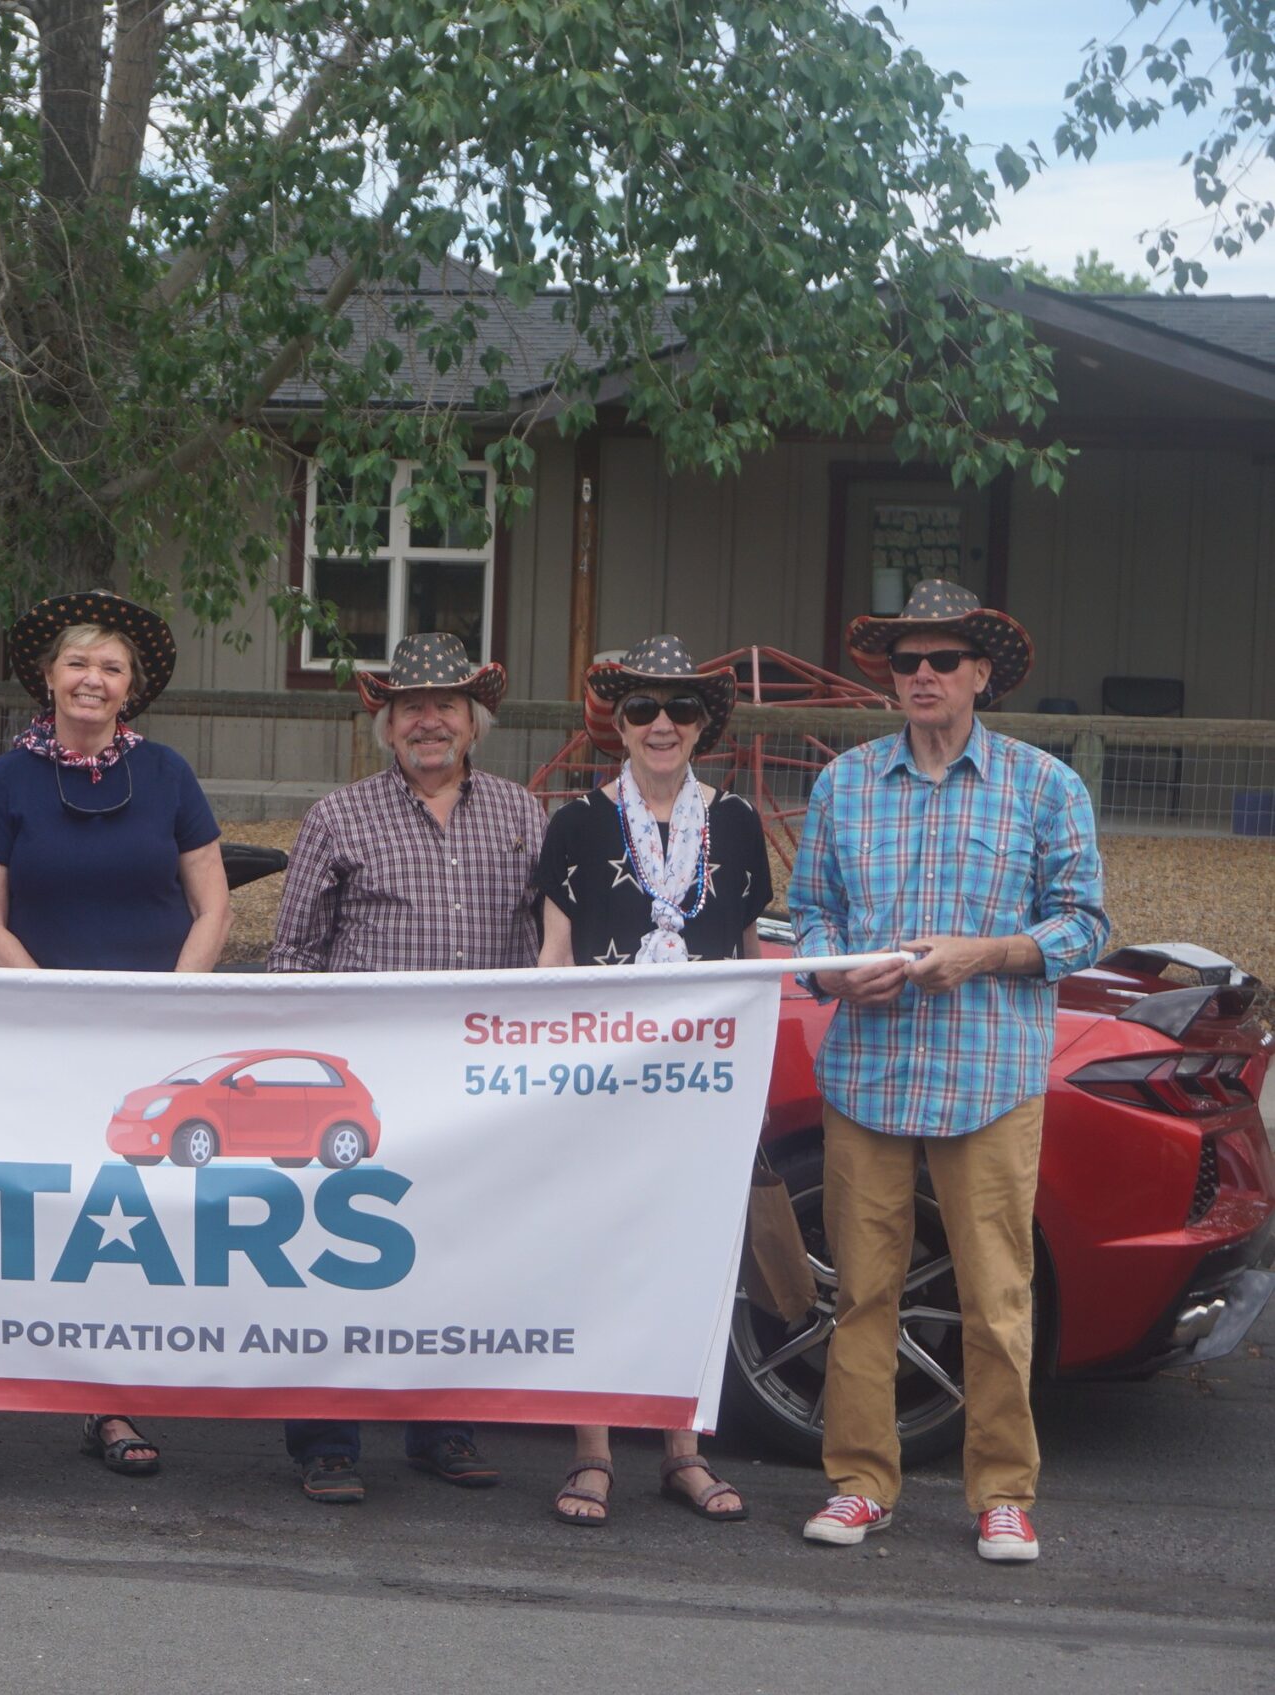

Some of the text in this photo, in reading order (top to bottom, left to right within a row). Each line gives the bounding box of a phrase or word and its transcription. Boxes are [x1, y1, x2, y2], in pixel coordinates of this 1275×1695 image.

[464, 1011, 736, 1049] StarsRide.org
[465, 1062, 734, 1095] 541-904-5545
[239, 1324, 329, 1354] AND
